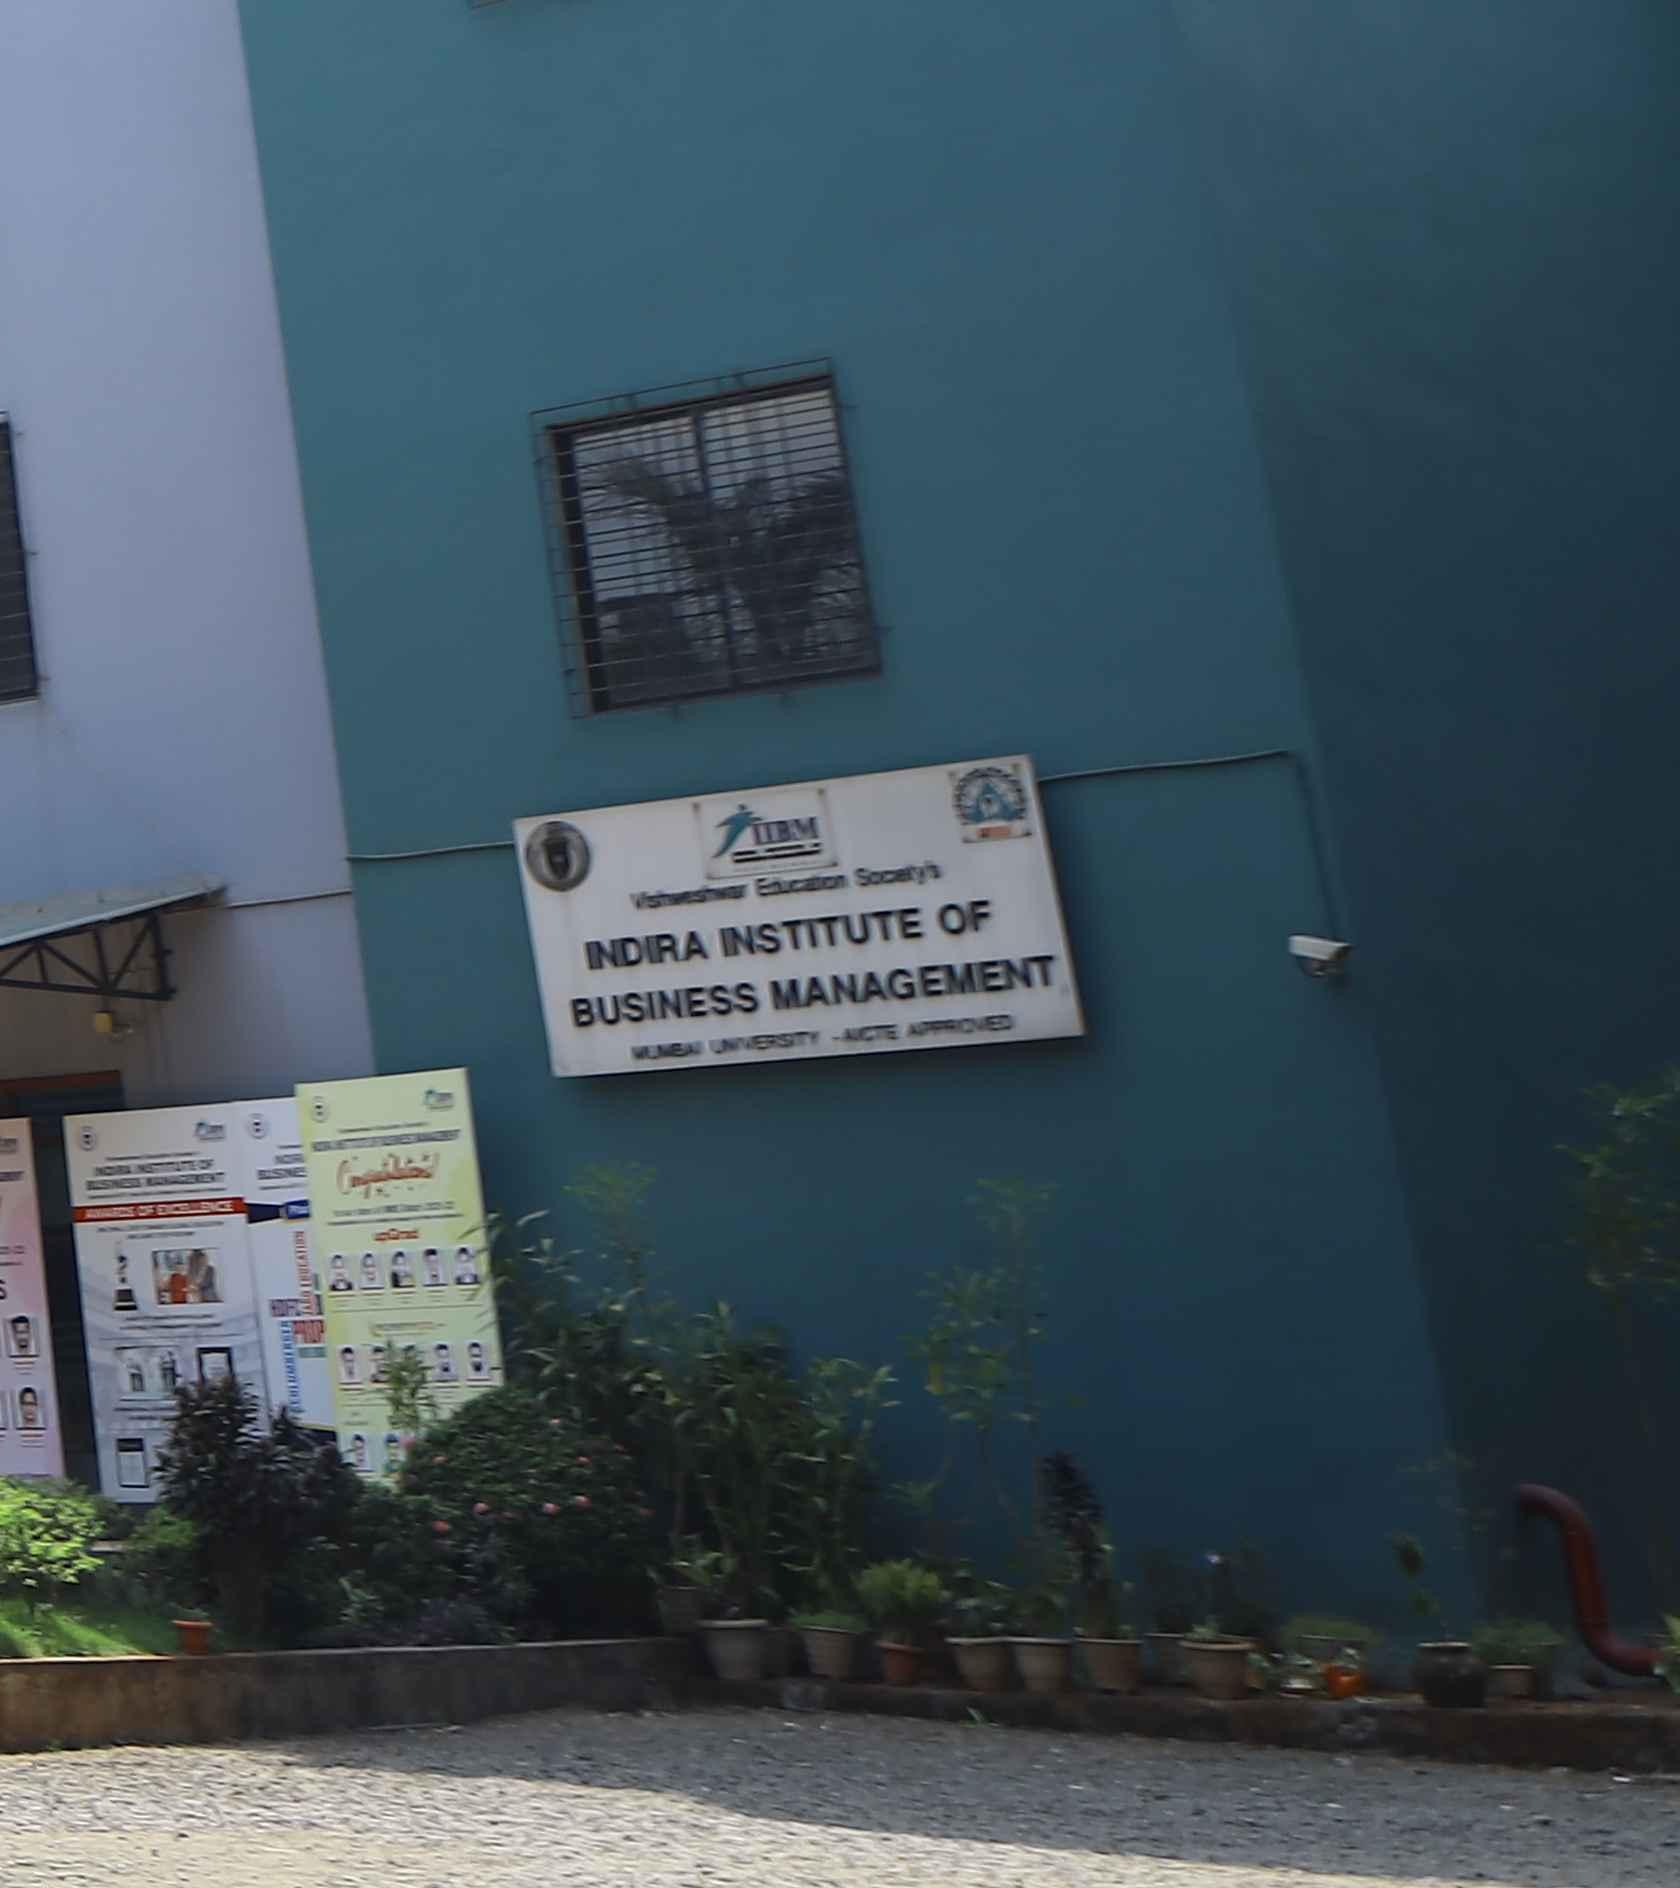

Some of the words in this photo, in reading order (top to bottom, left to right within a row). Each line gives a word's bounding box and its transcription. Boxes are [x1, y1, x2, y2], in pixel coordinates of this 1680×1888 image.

[755, 874, 846, 897] Education
[585, 930, 708, 971] INDIRA
[720, 907, 923, 957] INSTITUTE
[939, 899, 990, 935] OF
[570, 982, 759, 1027] BUSINESS
[769, 954, 1054, 1011] MANAGEMENT
[631, 1041, 703, 1060] MUMBAI
[709, 1030, 818, 1054] UNIVERSITY
[907, 1014, 1014, 1036] APPROVED
